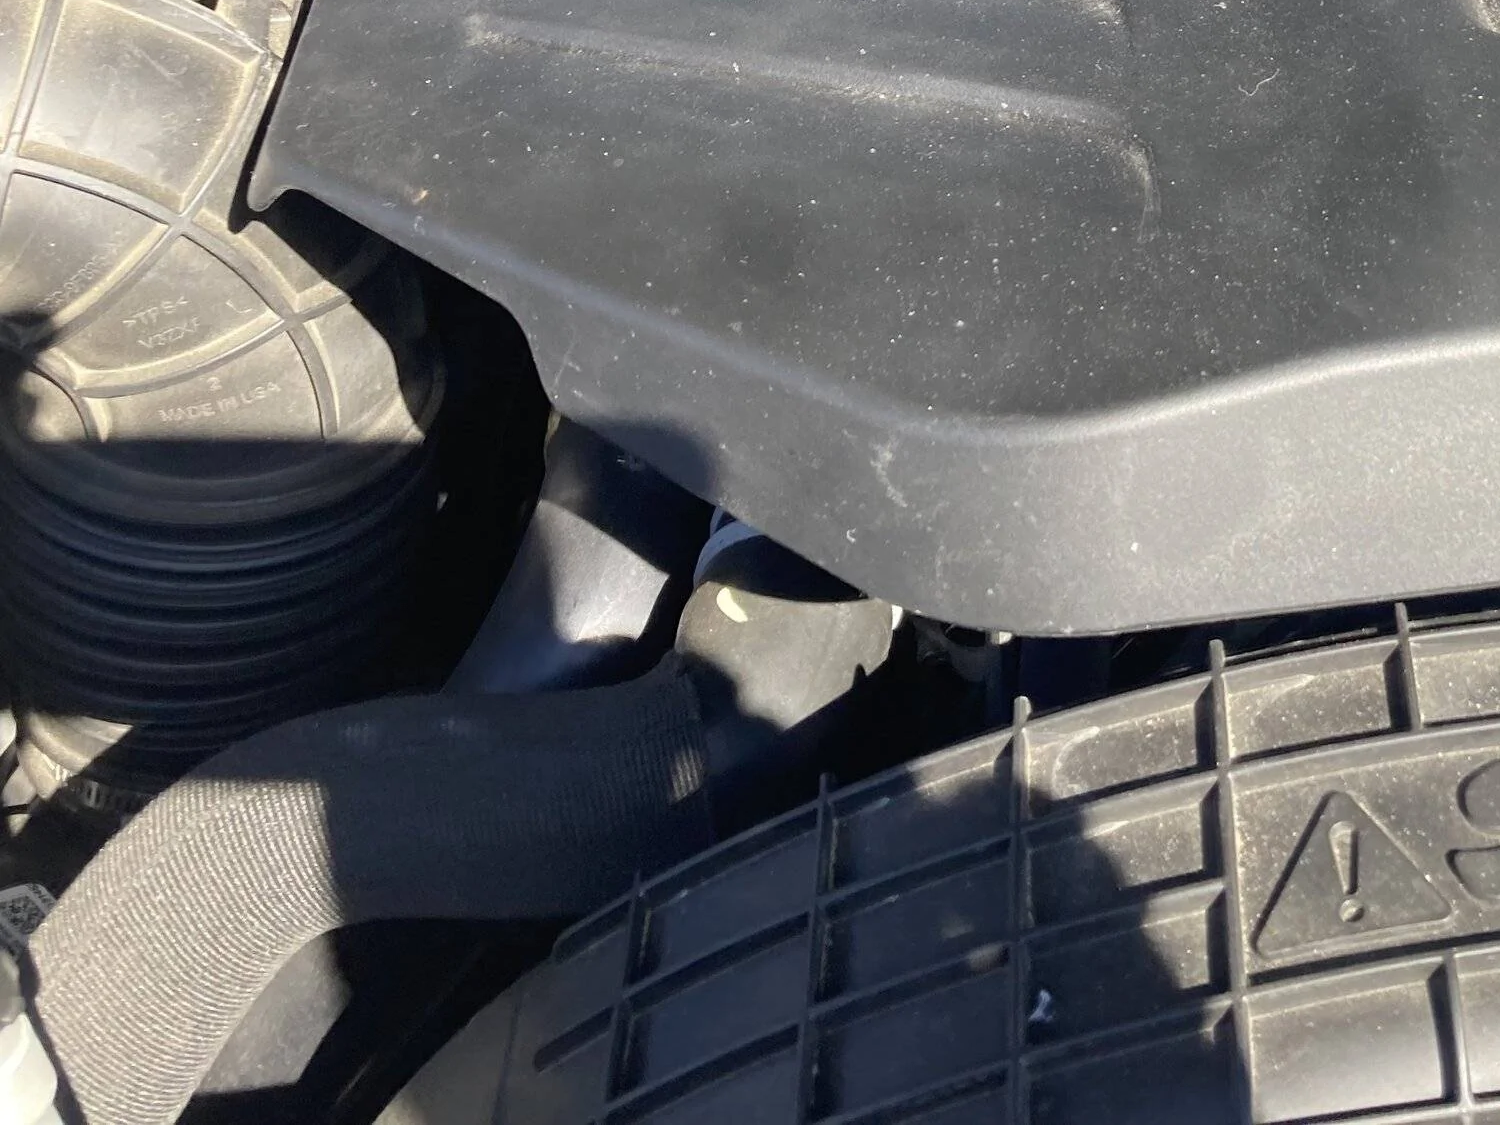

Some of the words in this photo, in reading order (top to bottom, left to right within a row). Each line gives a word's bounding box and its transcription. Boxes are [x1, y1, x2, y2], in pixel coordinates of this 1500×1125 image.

[158, 403, 216, 423] MADE
[217, 398, 238, 414] IN
[240, 381, 282, 406] USA
